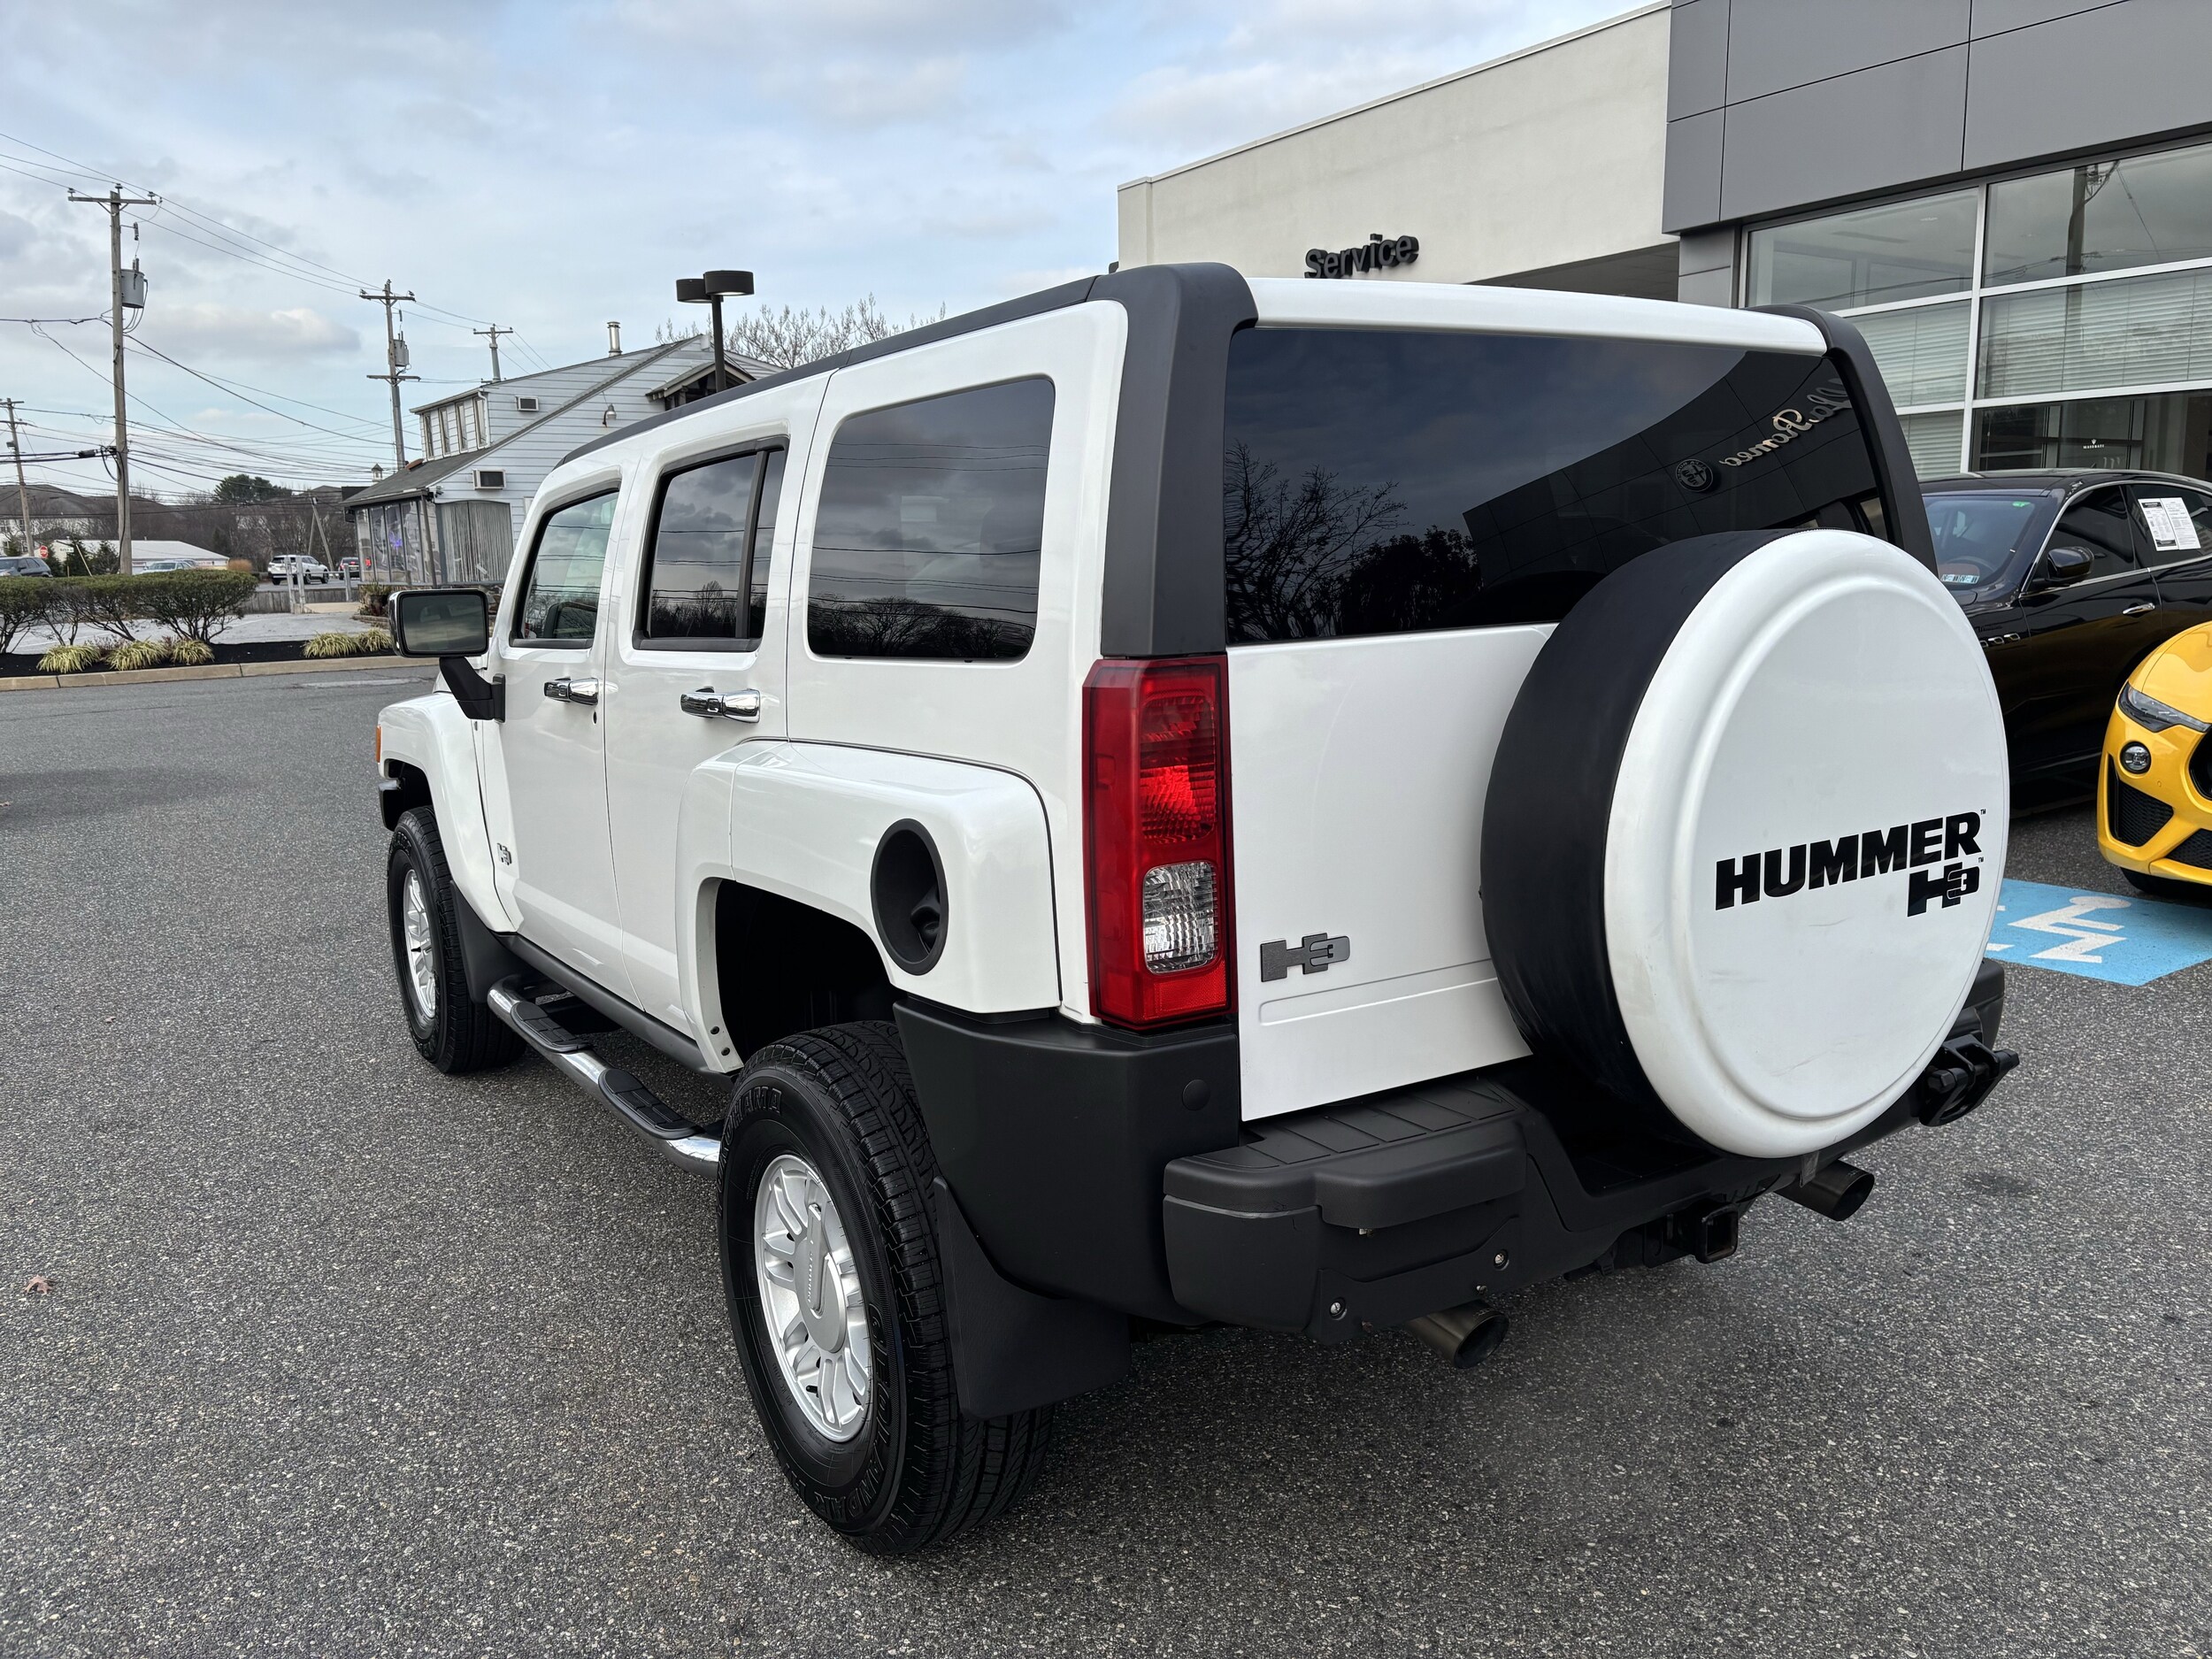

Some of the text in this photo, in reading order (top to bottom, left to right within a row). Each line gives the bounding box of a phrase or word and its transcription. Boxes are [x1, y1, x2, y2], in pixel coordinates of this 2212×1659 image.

[1304, 234, 1419, 279] Service
[1715, 811, 1982, 910] HUMMER
[1907, 862, 1980, 918] H3
[1260, 933, 1351, 982] H3
